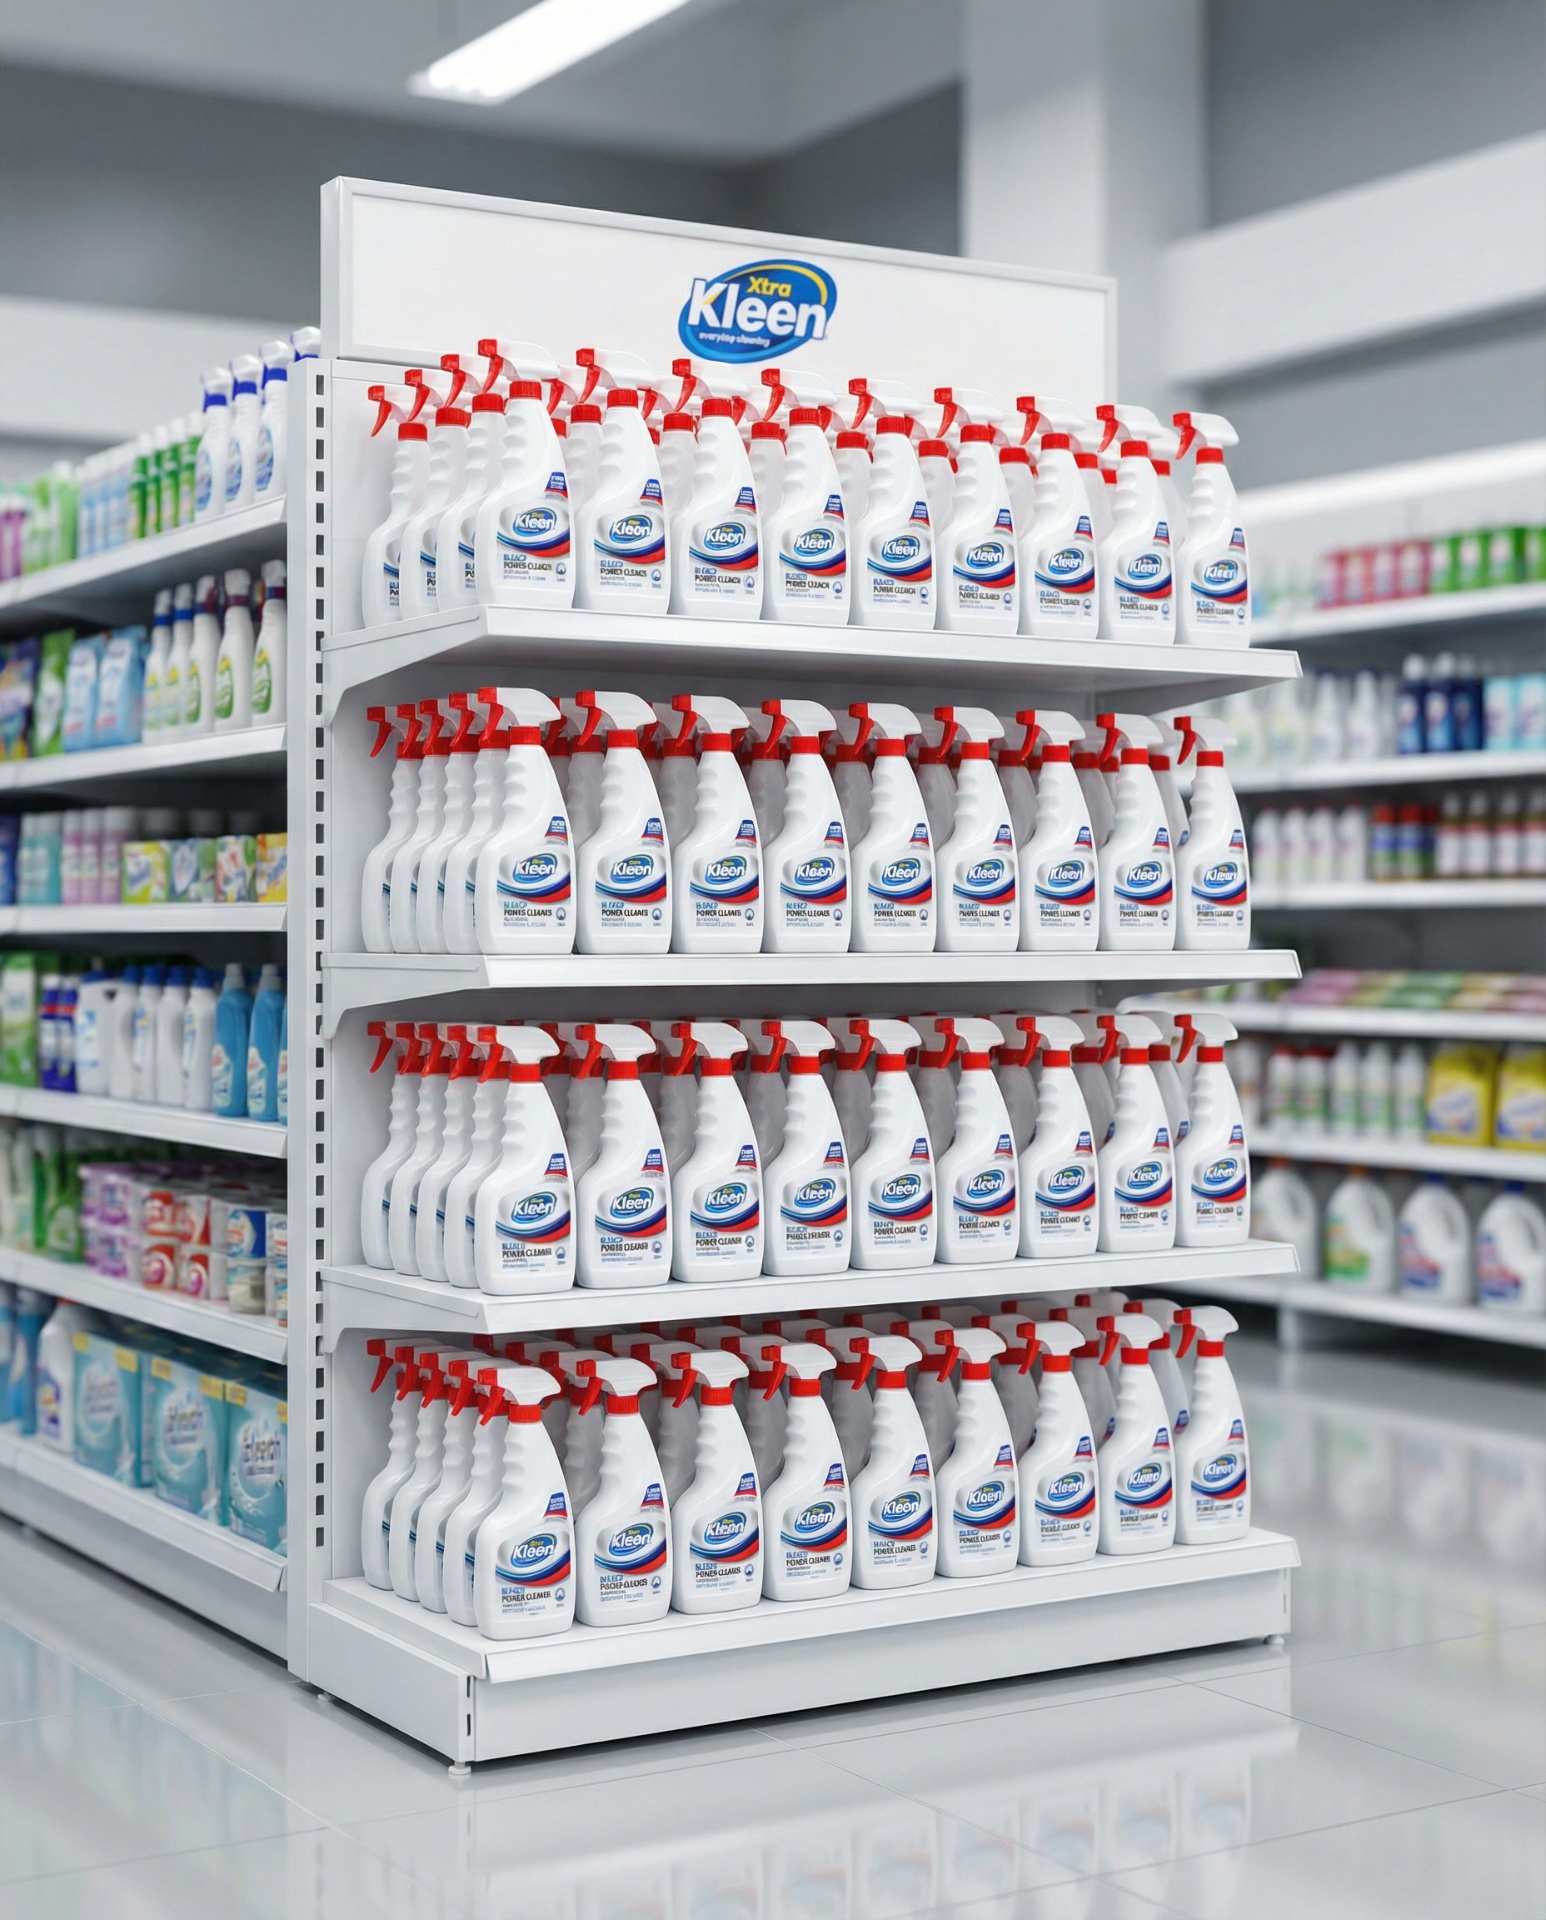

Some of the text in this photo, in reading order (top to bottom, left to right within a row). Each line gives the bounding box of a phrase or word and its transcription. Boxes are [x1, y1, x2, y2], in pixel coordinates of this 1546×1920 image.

[746, 276, 790, 299] Xtra
[687, 278, 827, 340] Kleen
[516, 861, 555, 874] Kleen
[613, 1195, 651, 1209] Kleen
[513, 1543, 554, 1559] Kleen
